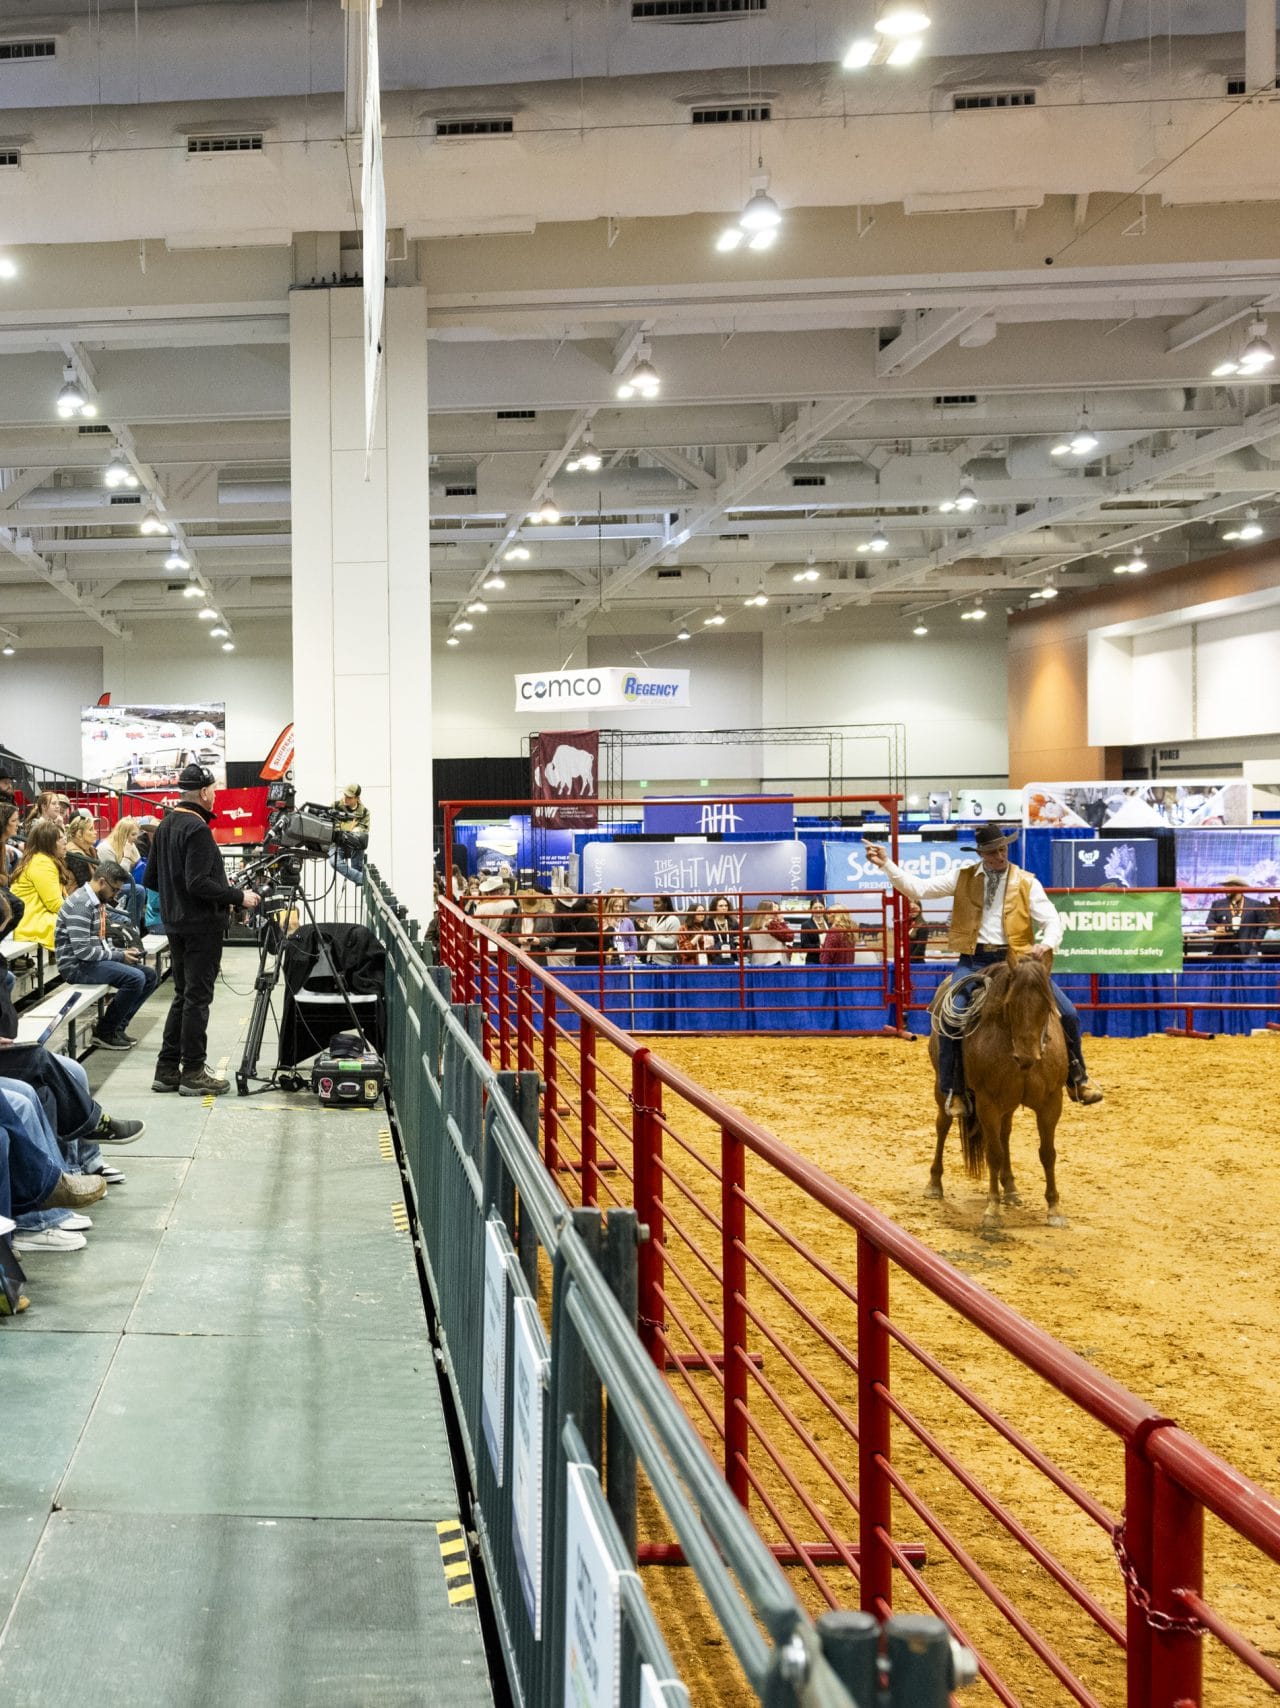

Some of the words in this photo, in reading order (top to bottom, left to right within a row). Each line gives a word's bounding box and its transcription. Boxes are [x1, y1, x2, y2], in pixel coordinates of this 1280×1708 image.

[521, 677, 601, 700] comco
[625, 677, 679, 697] REGENCY
[654, 859, 674, 871] THE
[654, 857, 705, 889] RIGHT
[706, 853, 747, 886] WAY
[858, 881, 893, 889] PREMIU
[1058, 911, 1154, 931] NEOGEN
[1070, 947, 1097, 955] Animal
[1098, 947, 1123, 955] Health
[1124, 947, 1138, 955] and
[1139, 947, 1164, 957] Safety
